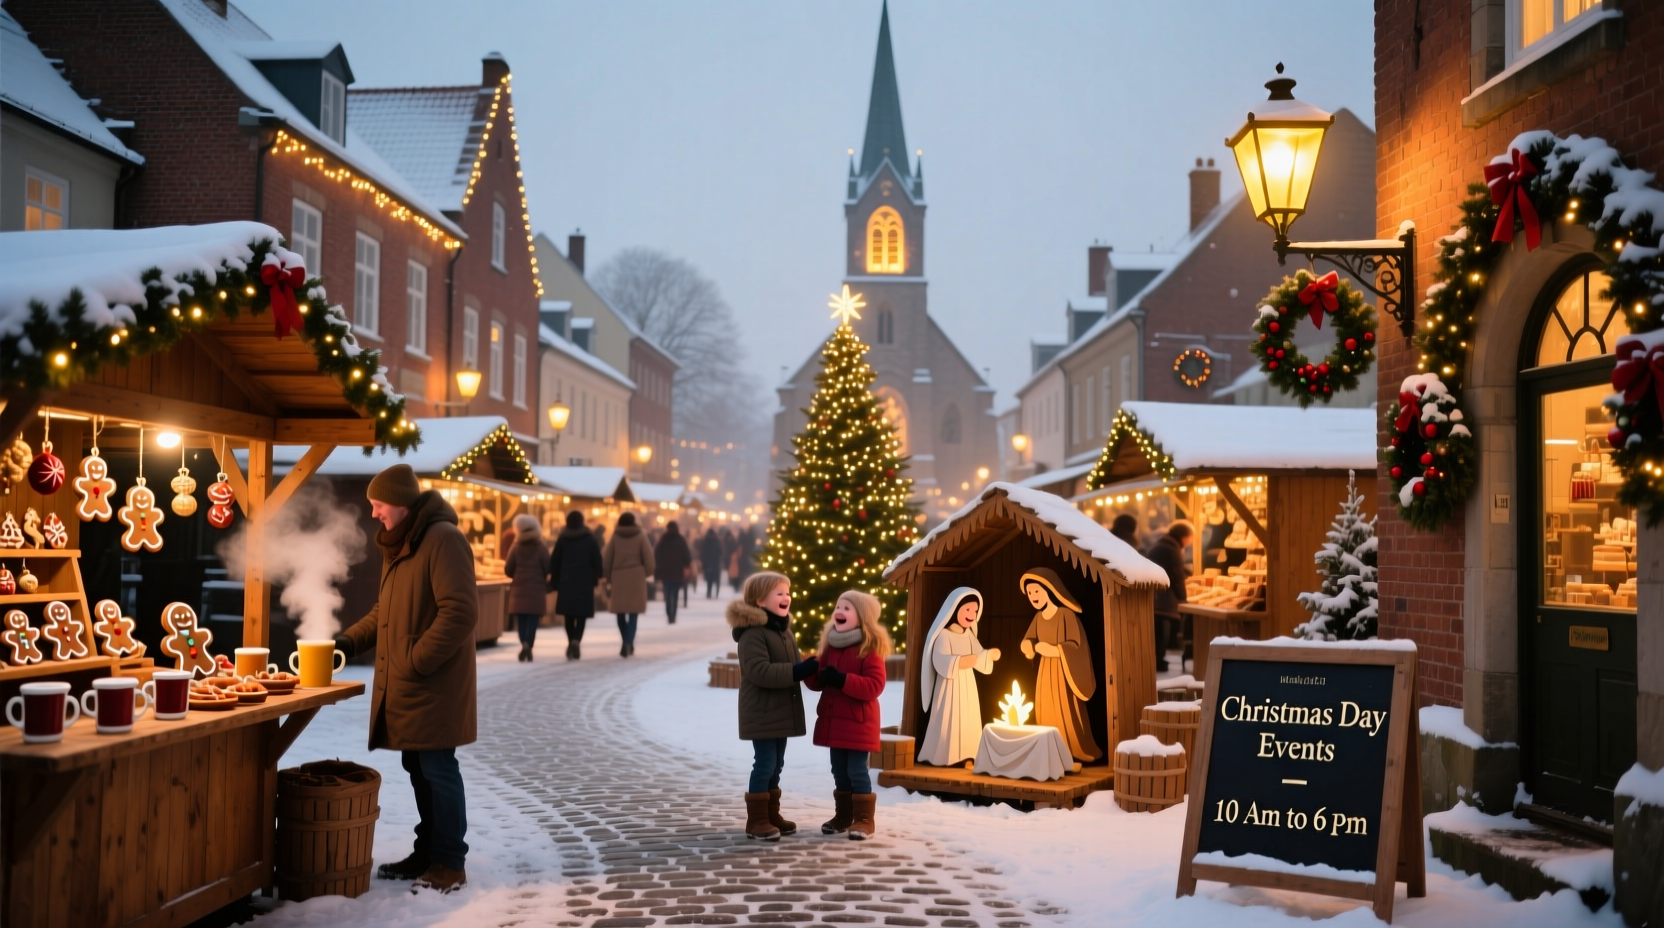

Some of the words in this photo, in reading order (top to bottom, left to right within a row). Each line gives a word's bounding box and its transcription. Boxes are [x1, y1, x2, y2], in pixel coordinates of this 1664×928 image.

[1221, 695, 1333, 726] Christmas
[1338, 701, 1388, 737] Day
[1256, 732, 1335, 762] Events
[1213, 799, 1239, 824] 10
[1242, 800, 1281, 827] Am
[1286, 807, 1308, 830] to
[1313, 806, 1327, 831] 6
